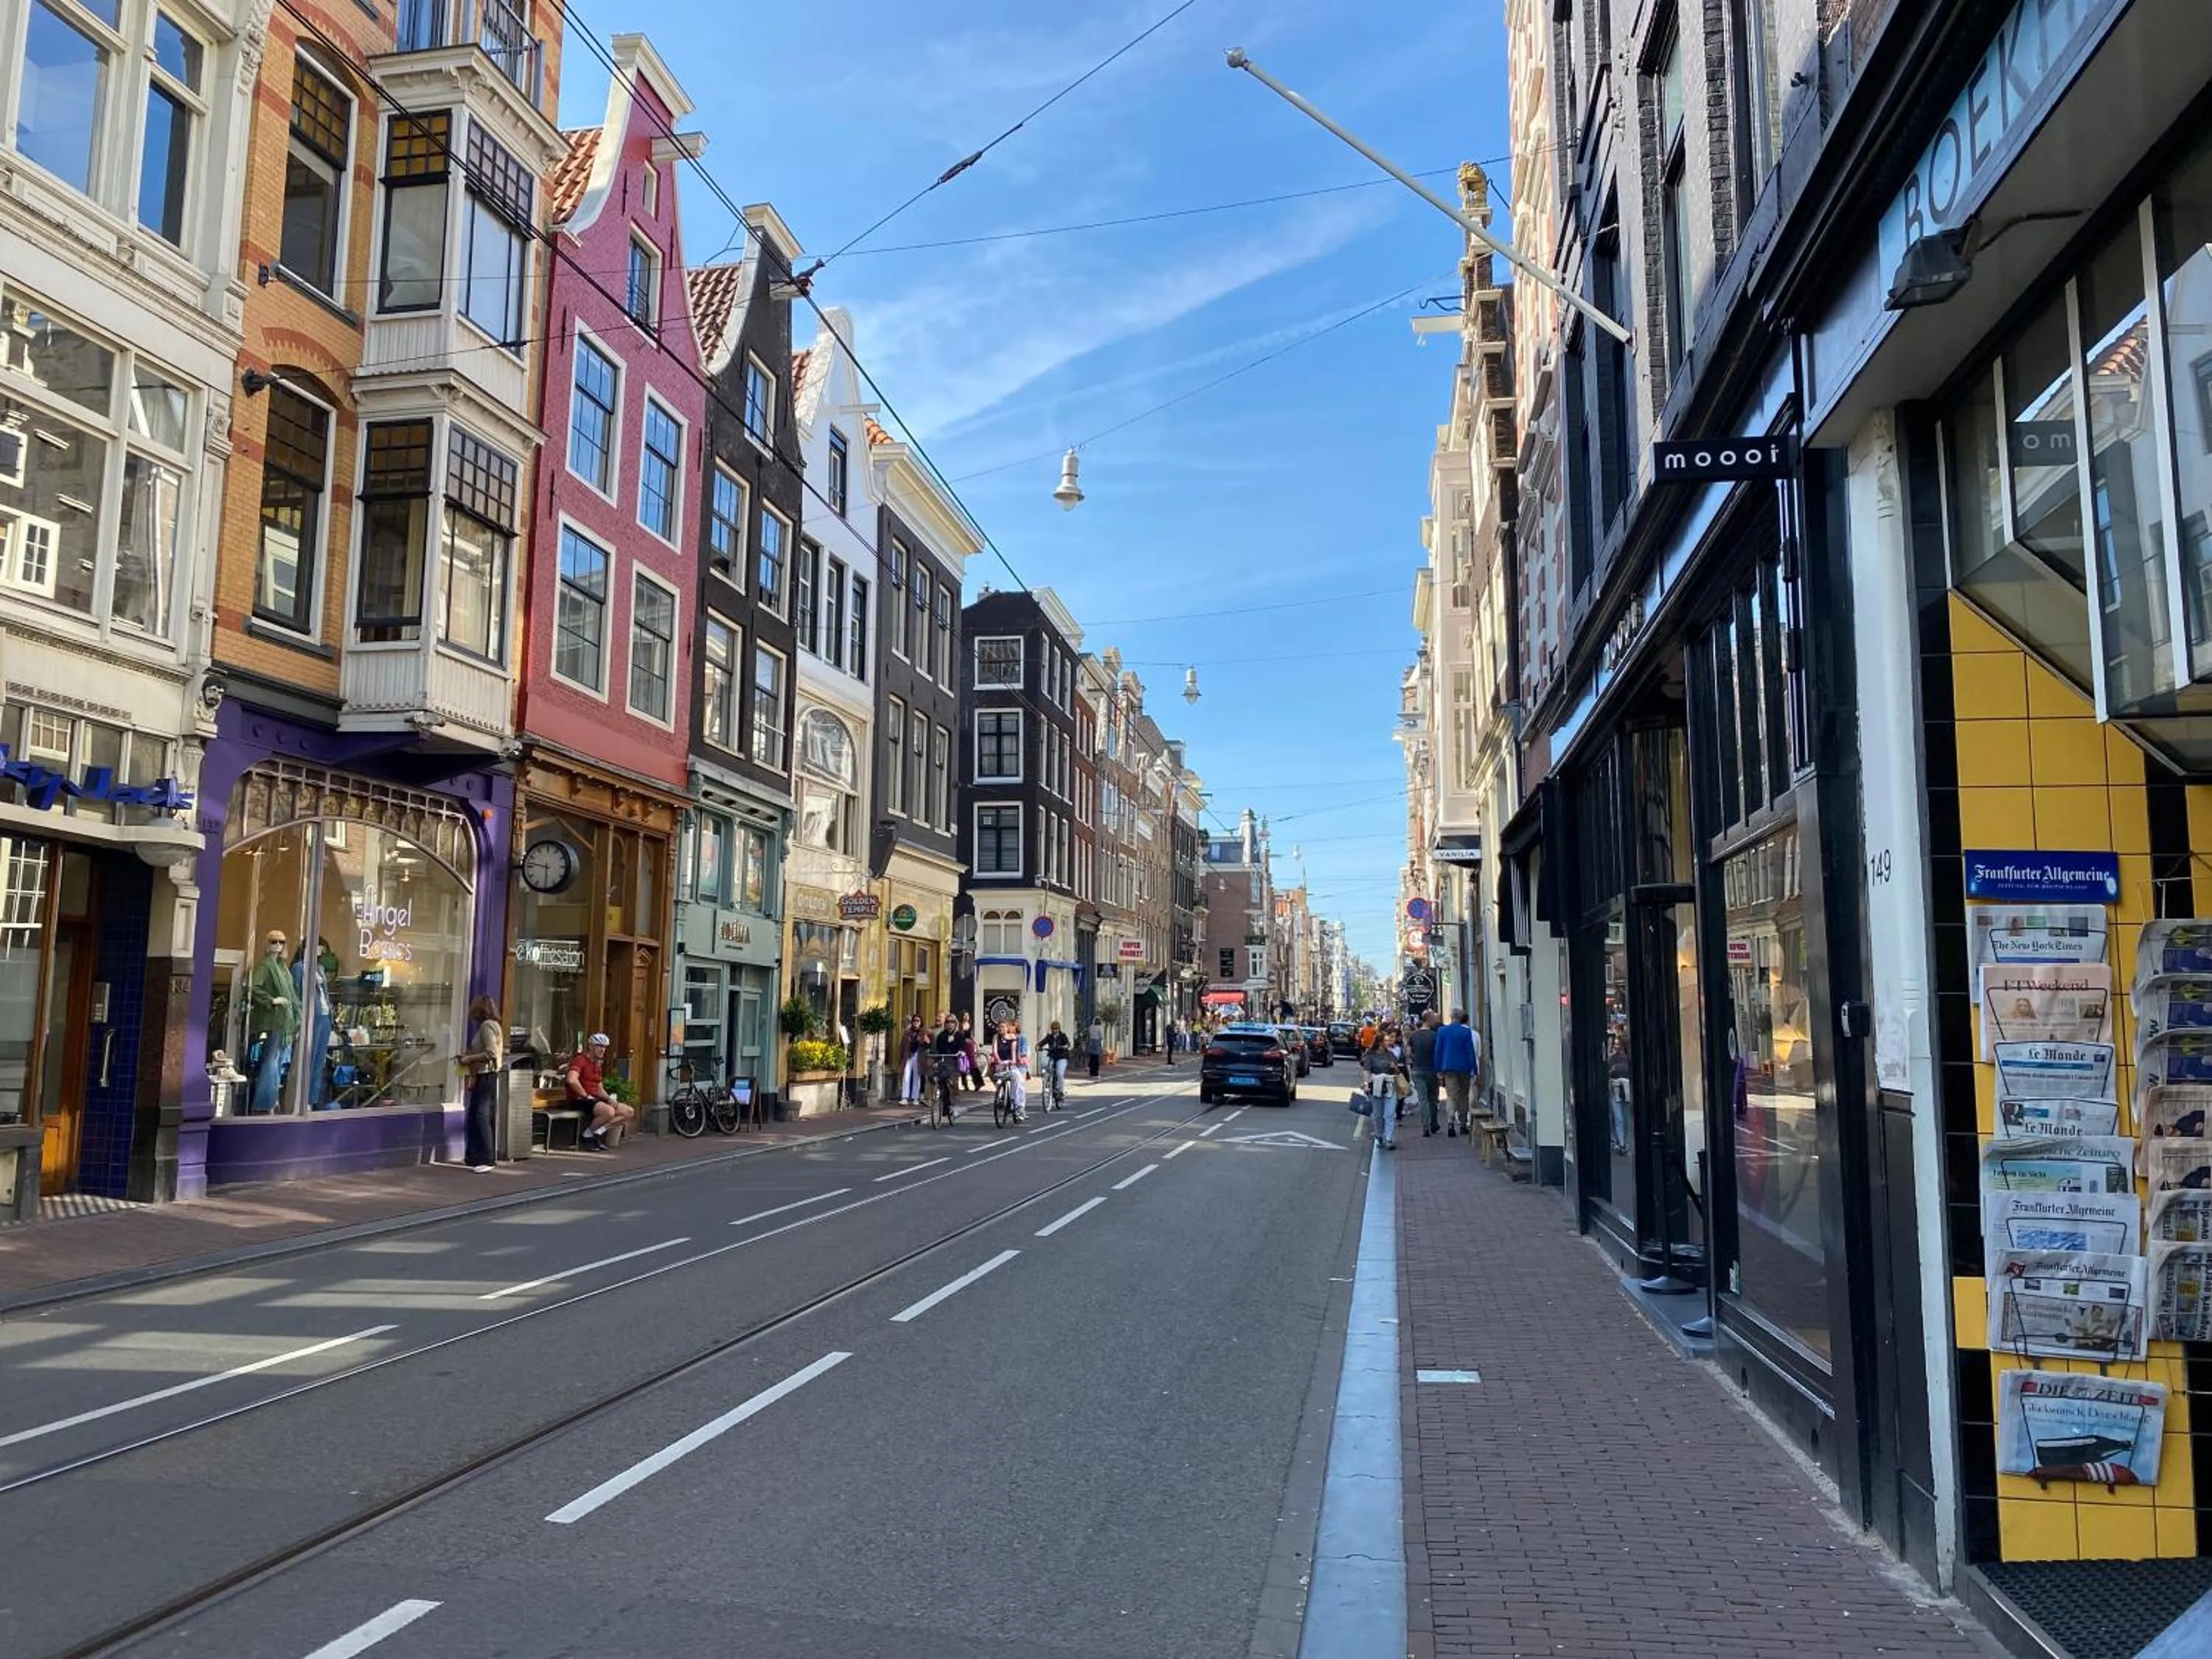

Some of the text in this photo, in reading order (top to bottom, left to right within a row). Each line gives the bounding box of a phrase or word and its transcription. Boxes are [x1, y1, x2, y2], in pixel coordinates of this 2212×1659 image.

[1664, 444, 1779, 469] moooi
[1870, 849, 1891, 887] 149
[1974, 863, 2110, 884] Frankfurter Allgemeine
[841, 896, 877, 905] GOLDEN
[363, 884, 413, 936] Angel
[841, 904, 877, 914] TEMPLE
[1993, 940, 2084, 952] The New York Times
[2028, 1048, 2087, 1061] Le Monde
[2024, 1121, 2083, 1136] Le Monde
[2077, 1145, 2121, 1161] Zeitung
[2012, 1200, 2115, 1217] Frankfurter Allgemeine
[2039, 1382, 2138, 1405] DIE ZEIT
